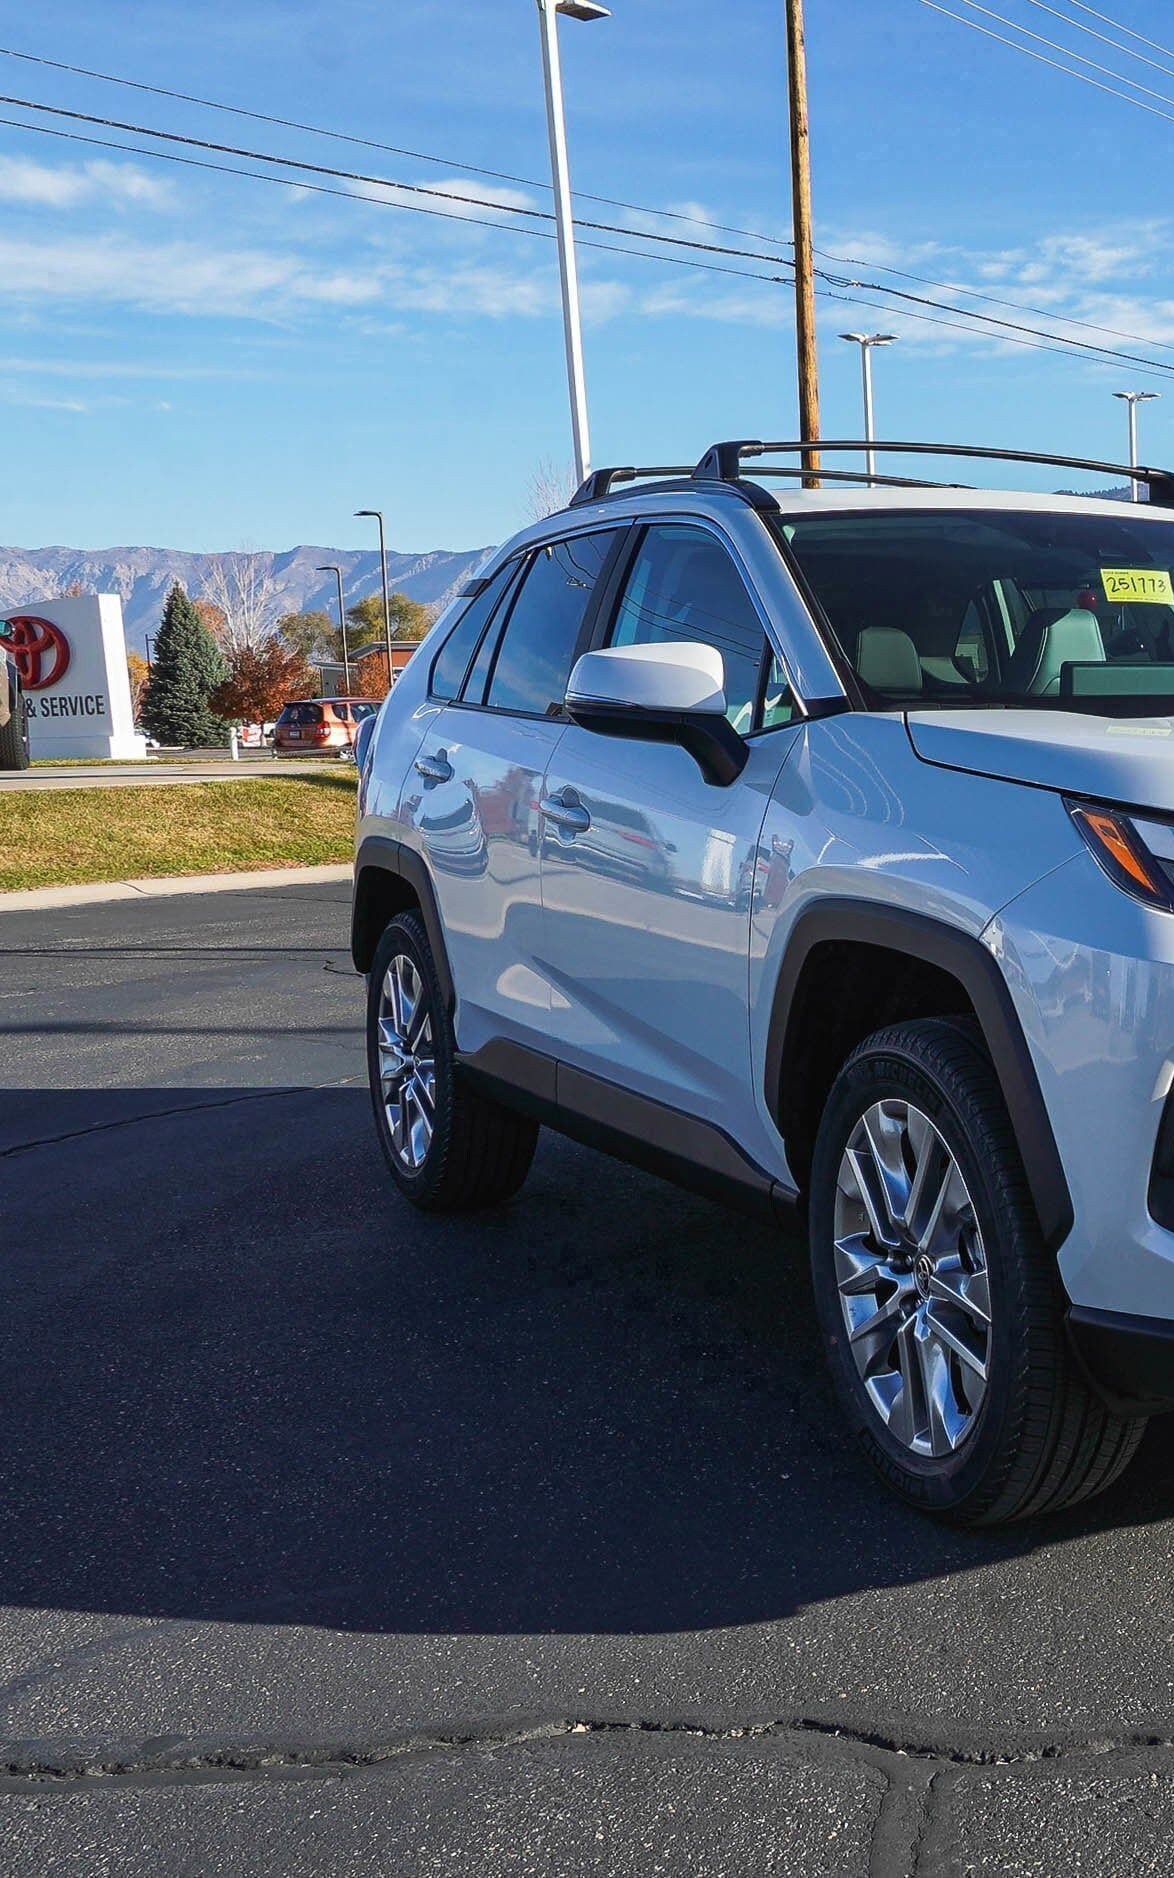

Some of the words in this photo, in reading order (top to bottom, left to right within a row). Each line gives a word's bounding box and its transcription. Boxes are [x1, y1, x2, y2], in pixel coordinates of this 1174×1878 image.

[1106, 576, 1167, 594] 251773
[25, 697, 37, 718] &
[40, 694, 106, 718] SERVICE
